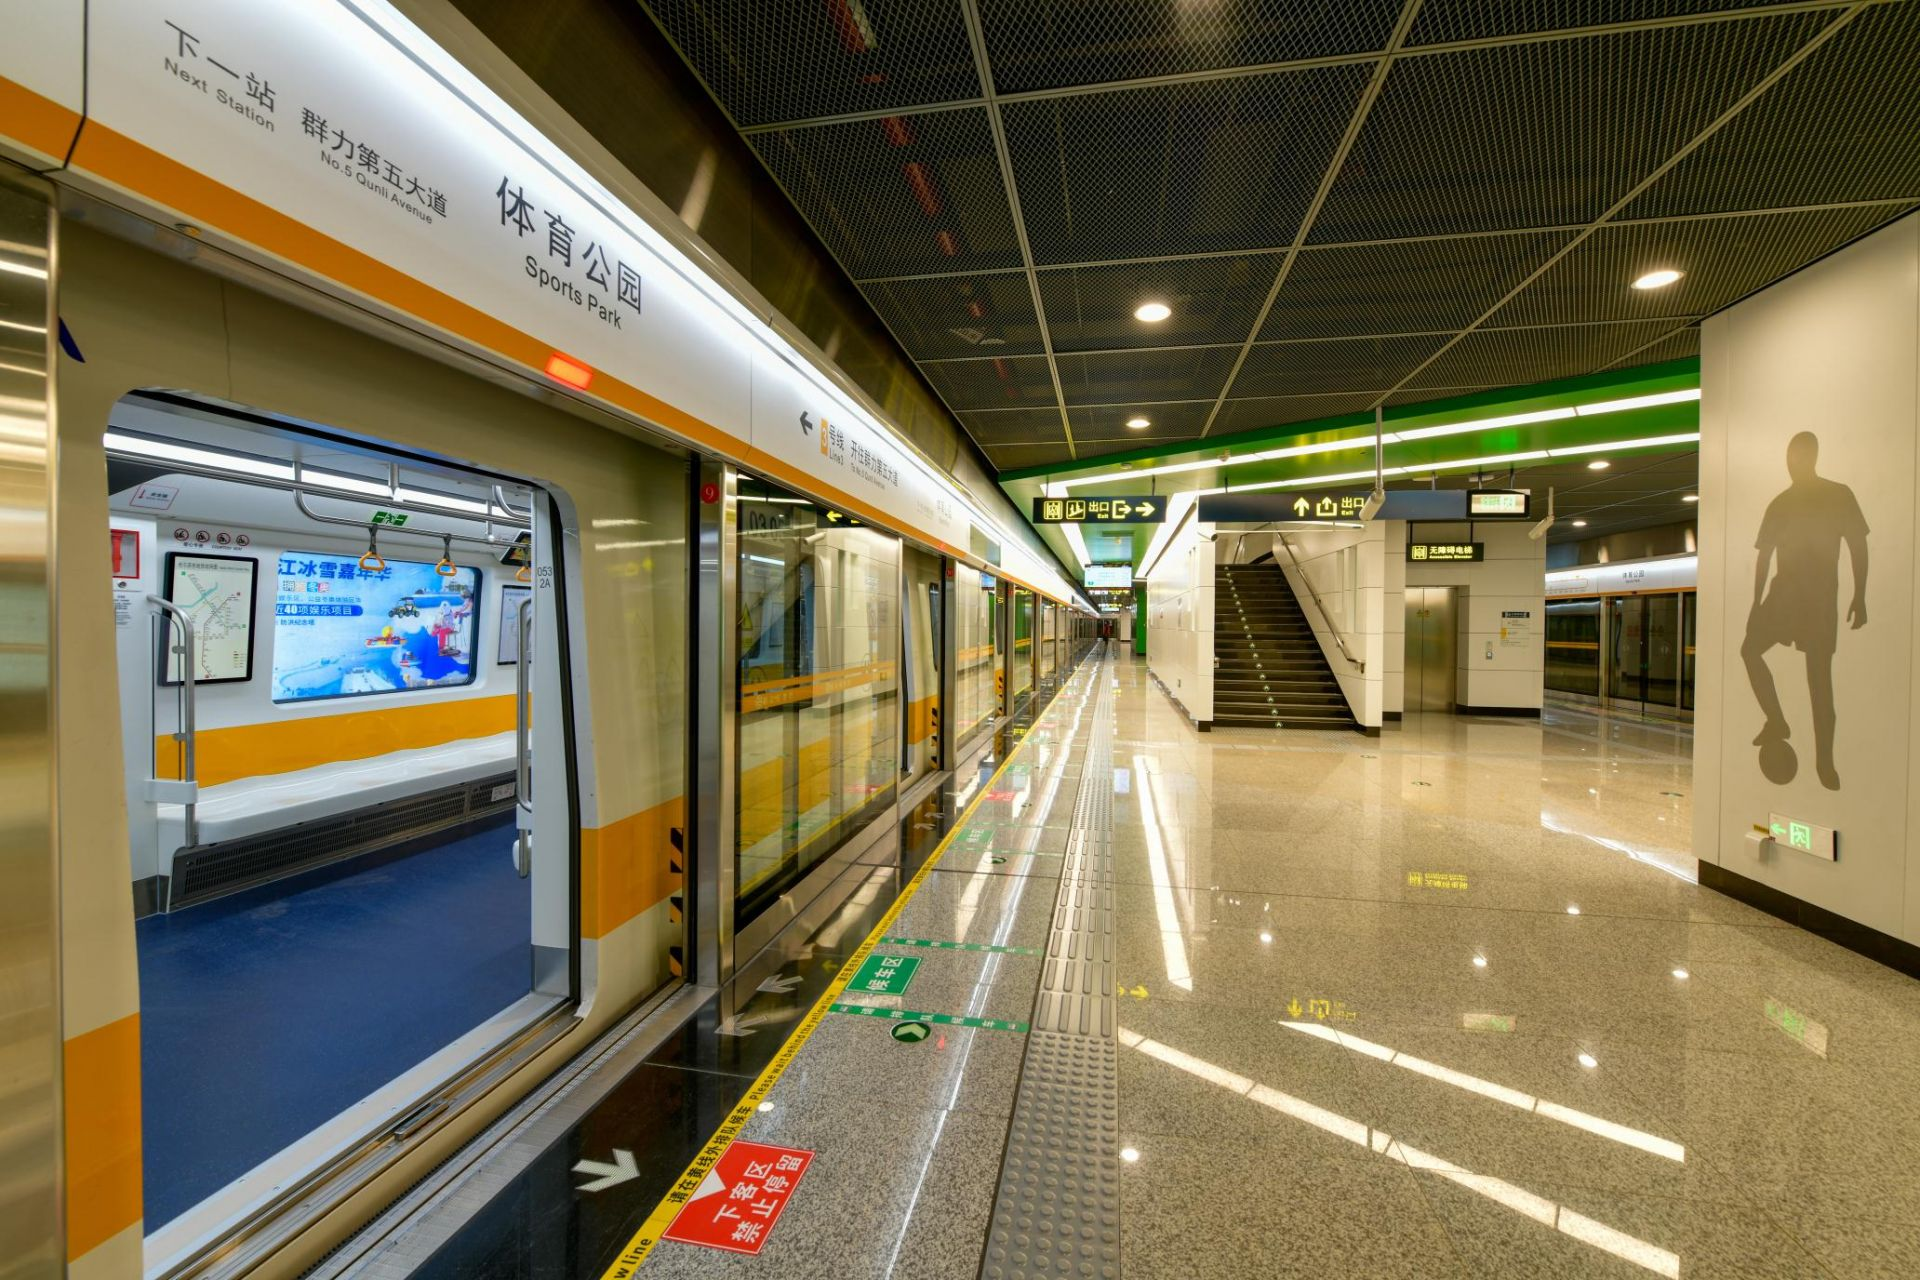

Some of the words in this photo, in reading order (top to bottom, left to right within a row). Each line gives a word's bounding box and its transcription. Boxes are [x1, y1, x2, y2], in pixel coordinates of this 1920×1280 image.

[164, 57, 208, 94] Next
[216, 88, 275, 132] Station
[165, 20, 275, 113] 下一站
[301, 107, 448, 218] 群力第五大道
[320, 150, 353, 177] No.5
[356, 171, 389, 199] Qunli
[390, 192, 433, 224] Avenue
[496, 175, 642, 315] 体育公园
[525, 255, 583, 306] Sports
[587, 293, 622, 330] Park
[1089, 501, 1109, 512] 出口
[1341, 496, 1364, 508] 出口
[537, 566, 552, 577] 053
[540, 578, 551, 588] 2A
[1429, 545, 1473, 555] 无障碍电梯
[866, 956, 904, 991] 候车区
[748, 1073, 776, 1100] Please
[773, 1057, 787, 1074] wait
[780, 1035, 805, 1057] behind
[798, 1024, 814, 1033] the
[666, 1105, 753, 1204] 请在黄线外排队候车
[712, 1160, 773, 1224] 下客区
[731, 1154, 804, 1244] 禁止停留
[620, 1237, 652, 1269] line
